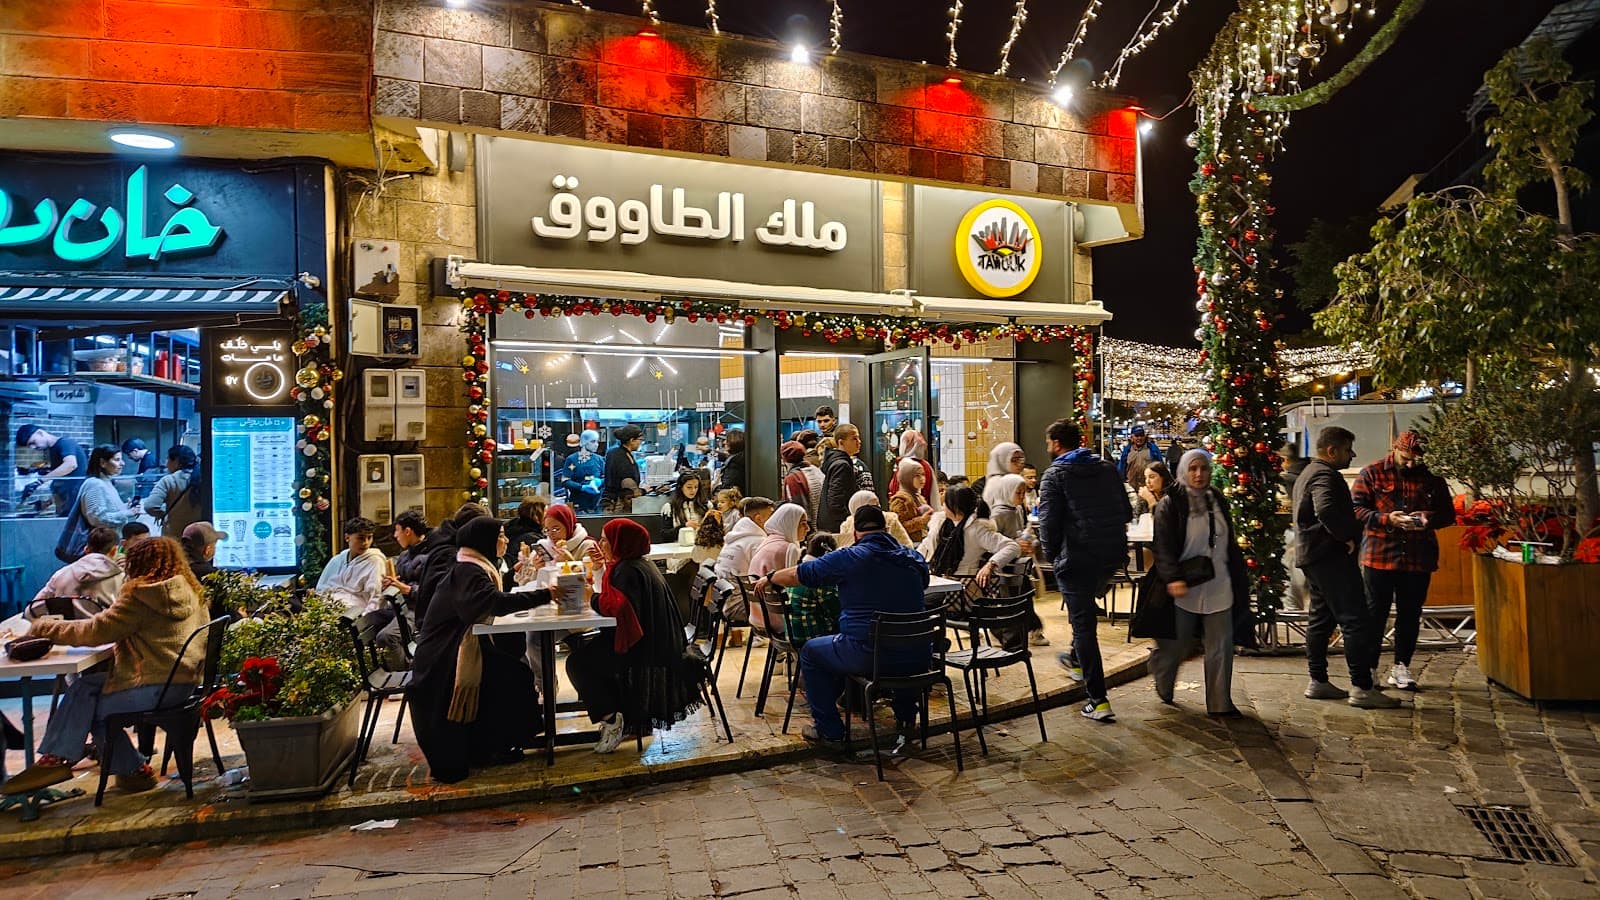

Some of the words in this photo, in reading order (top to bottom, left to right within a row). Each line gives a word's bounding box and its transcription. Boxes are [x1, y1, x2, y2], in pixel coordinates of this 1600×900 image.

[53, 165, 222, 261] خان
[531, 174, 745, 245] الطاووق
[755, 198, 848, 252] ملك
